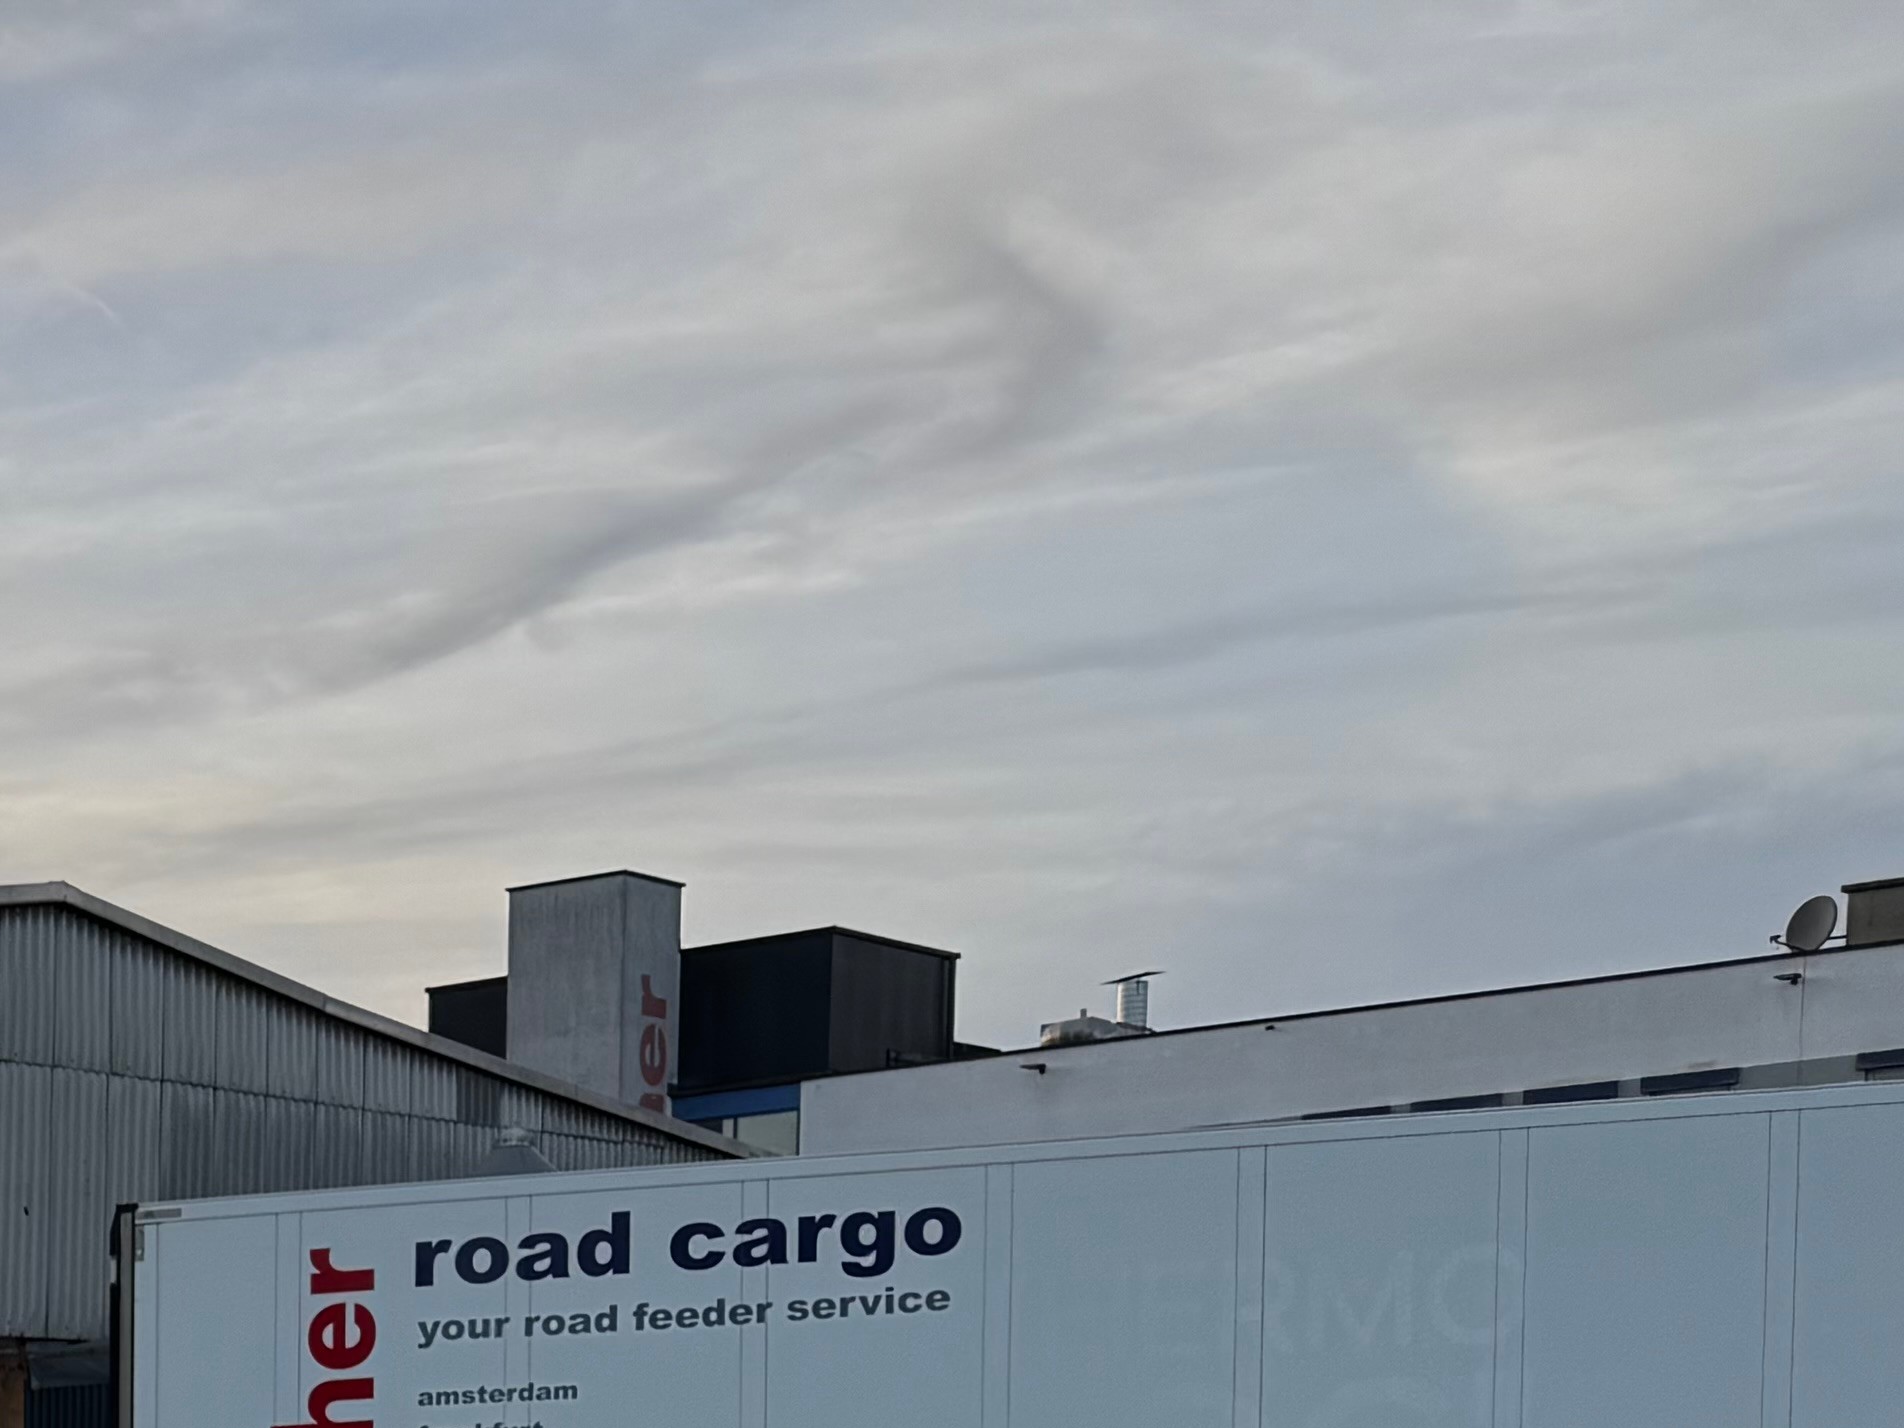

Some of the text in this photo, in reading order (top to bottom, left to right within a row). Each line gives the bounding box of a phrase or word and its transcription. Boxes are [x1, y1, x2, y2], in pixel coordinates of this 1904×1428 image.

[639, 973, 667, 1112] er
[414, 1204, 963, 1288] road cargo
[417, 1286, 952, 1350] your road feeder service
[417, 1381, 579, 1407] amsterdam
